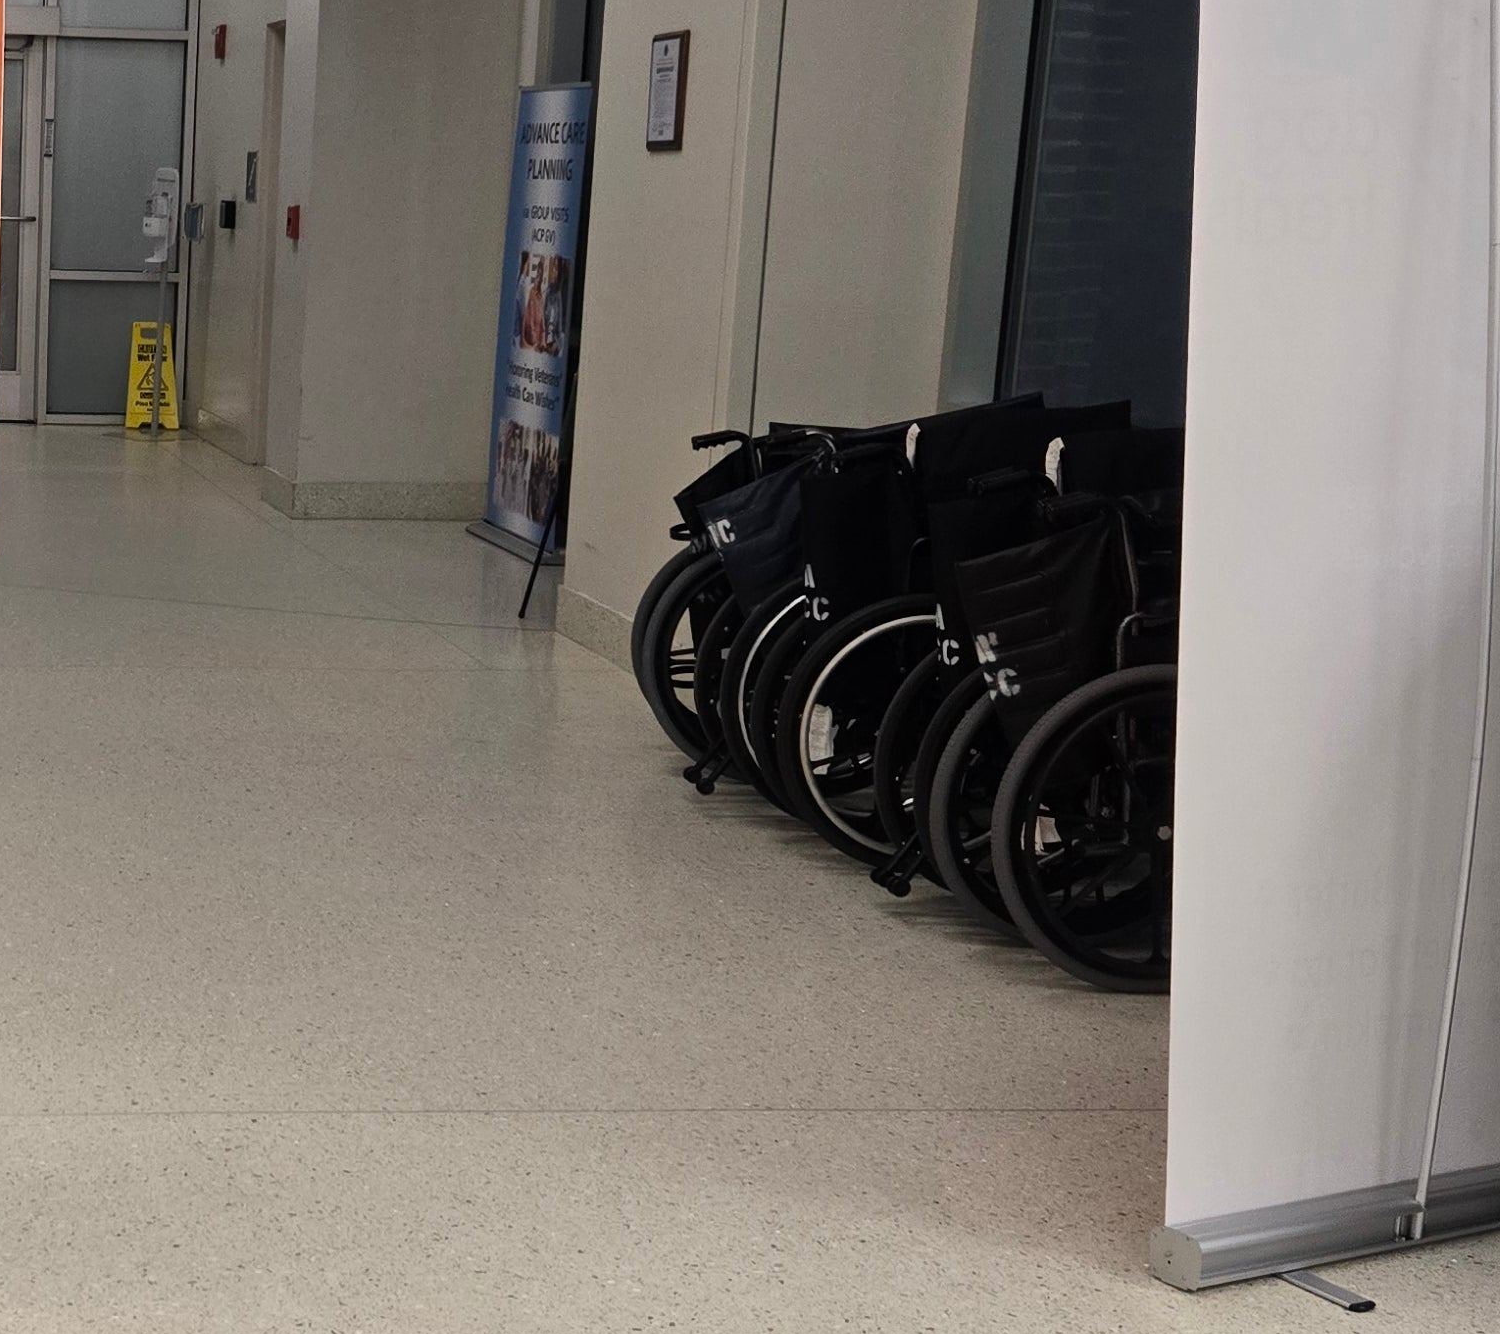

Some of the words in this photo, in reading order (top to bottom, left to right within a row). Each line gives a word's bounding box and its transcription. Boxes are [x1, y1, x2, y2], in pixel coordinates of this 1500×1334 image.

[521, 122, 560, 144] ADVANCE
[561, 122, 586, 144] CARE
[527, 158, 574, 182] PLANNING
[137, 354, 150, 362] Wet
